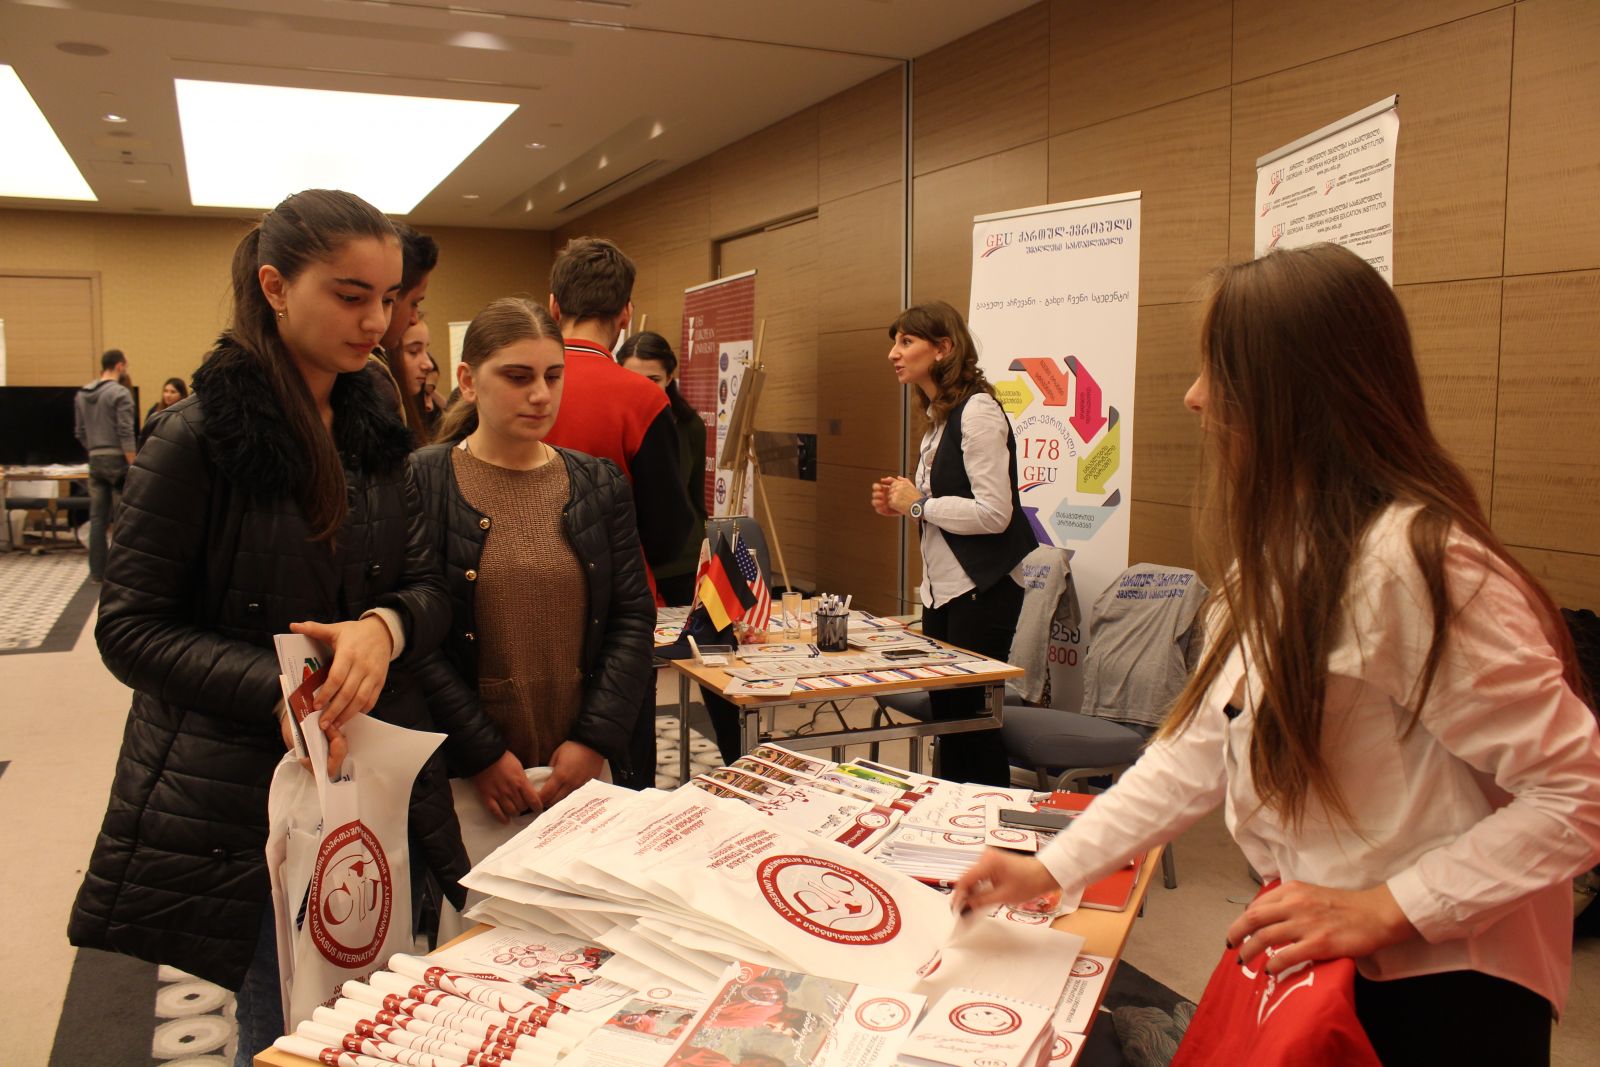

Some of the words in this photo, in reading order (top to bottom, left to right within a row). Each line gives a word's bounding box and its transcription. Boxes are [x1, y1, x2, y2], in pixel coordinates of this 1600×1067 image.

[986, 231, 1014, 248] GEU
[1018, 217, 1133, 244] ქართულ-ევროპული
[1022, 437, 1060, 461] 178
[1023, 465, 1058, 483] GEU
[803, 857, 852, 876] CAUCASUS
[762, 879, 796, 918] UNIVERSITY
[312, 913, 338, 956] CAUCASUS
[377, 885, 390, 938] UNIVERSITY
